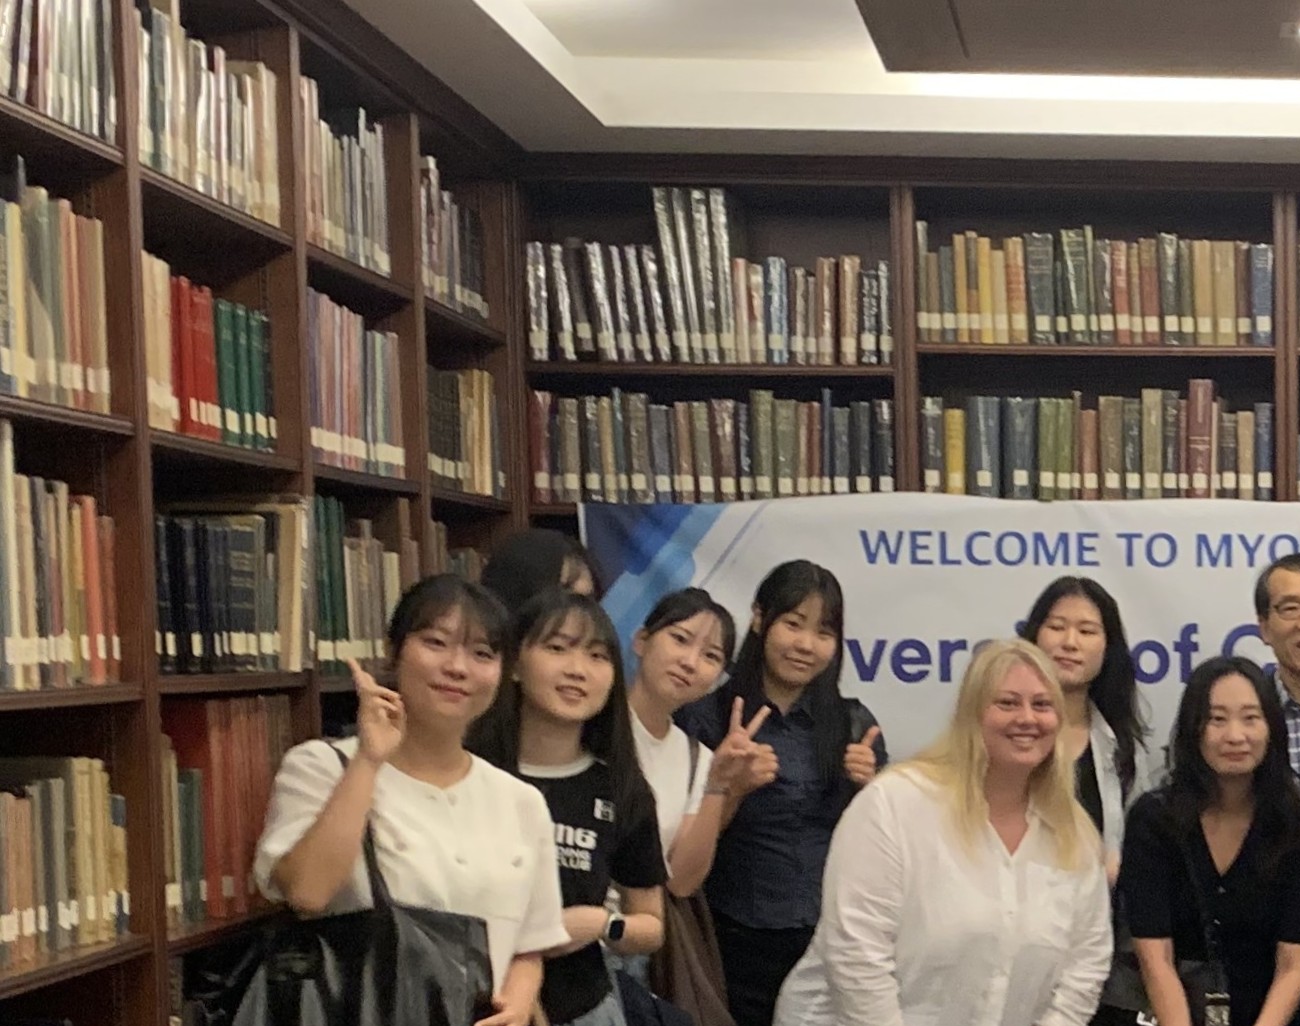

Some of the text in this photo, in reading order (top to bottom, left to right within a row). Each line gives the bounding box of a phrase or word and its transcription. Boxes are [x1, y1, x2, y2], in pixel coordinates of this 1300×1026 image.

[858, 529, 1101, 567] WELCOME
[1115, 532, 1178, 568] TO
[1132, 623, 1199, 685] of
